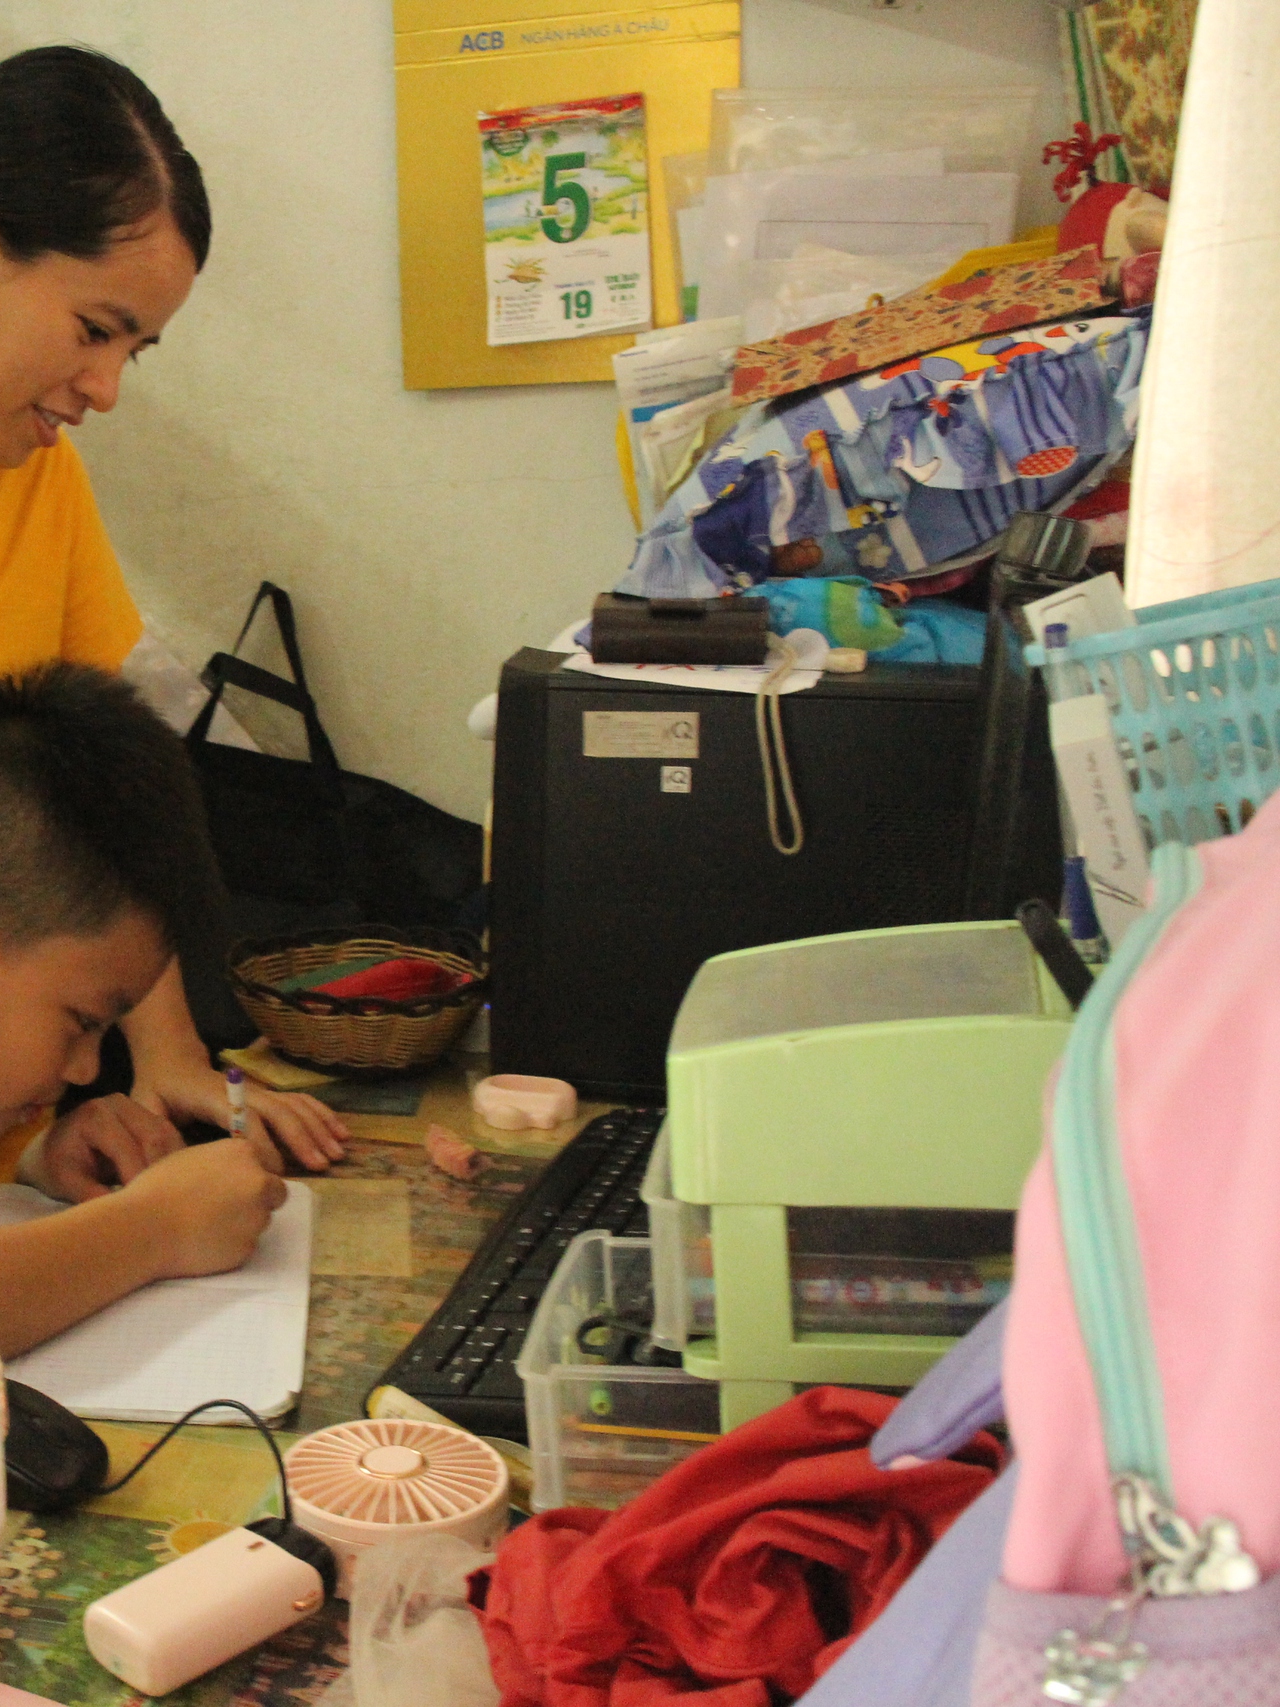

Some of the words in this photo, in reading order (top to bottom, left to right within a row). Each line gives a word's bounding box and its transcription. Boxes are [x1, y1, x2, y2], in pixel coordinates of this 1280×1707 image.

[459, 30, 505, 53] ACB
[540, 151, 591, 244] 5
[560, 289, 593, 320] 19
